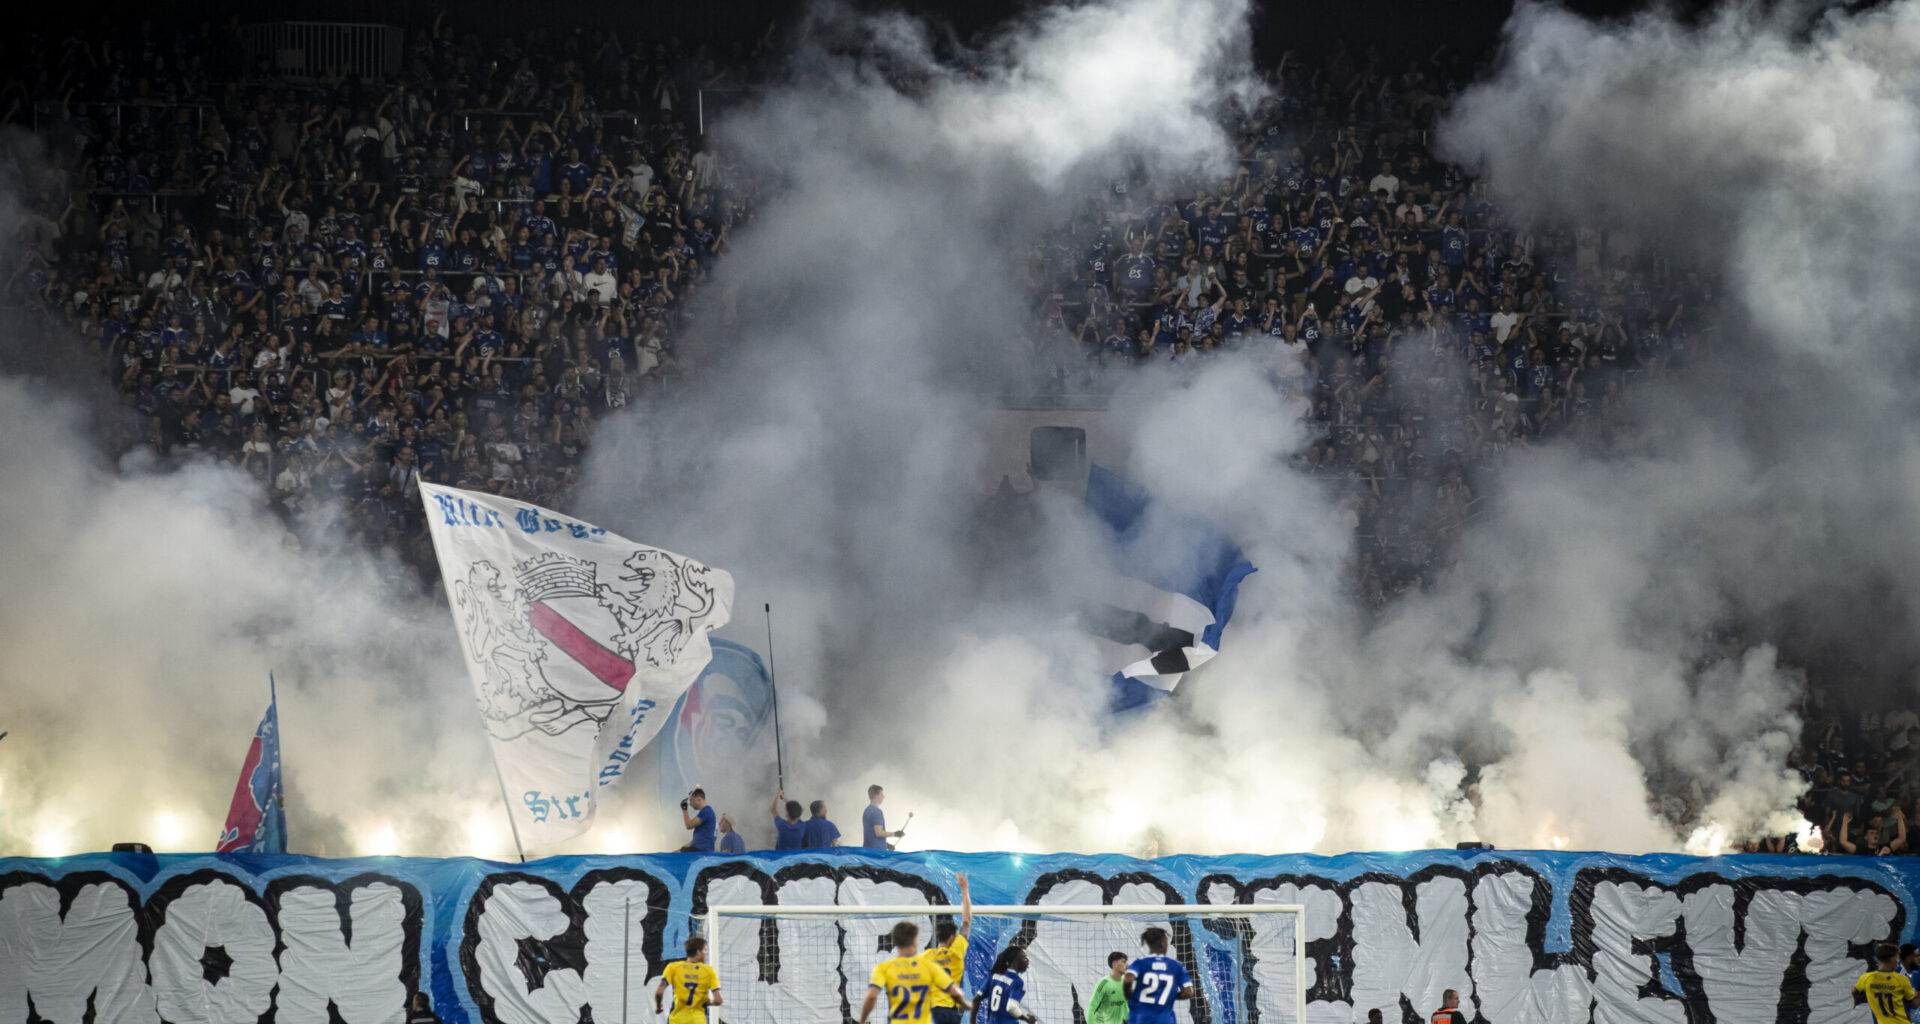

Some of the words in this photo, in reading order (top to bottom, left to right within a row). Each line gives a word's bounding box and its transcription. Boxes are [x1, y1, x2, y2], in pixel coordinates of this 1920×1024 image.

[0, 874, 414, 1024] MON
[684, 982, 698, 1006] 7
[892, 984, 929, 1020] 27
[990, 985, 1003, 1012] 6
[1139, 972, 1174, 1006] 27
[1874, 992, 1896, 1017] 11
